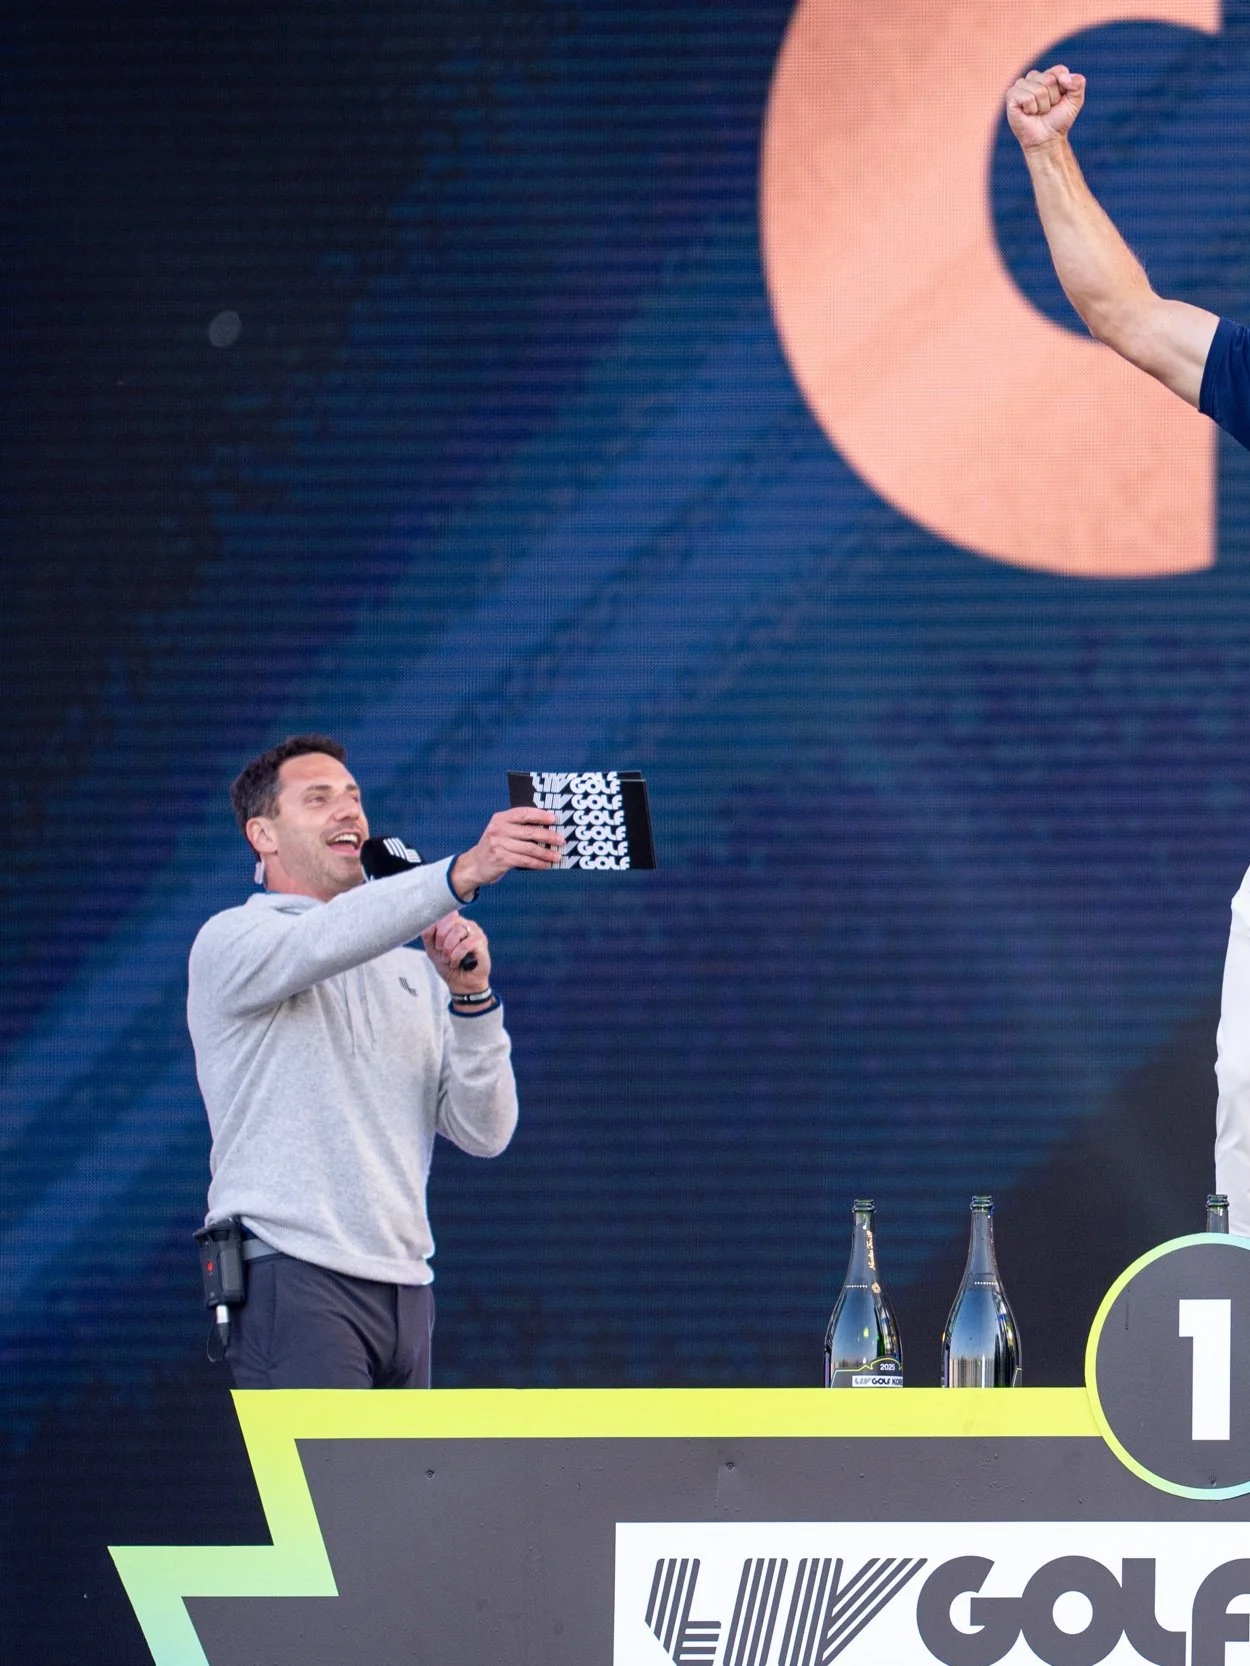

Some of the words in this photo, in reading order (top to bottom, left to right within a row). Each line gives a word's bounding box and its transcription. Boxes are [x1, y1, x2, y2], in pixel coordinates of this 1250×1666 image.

[569, 777, 621, 794] GOLF
[533, 792, 573, 809] LIV
[571, 794, 622, 810] GOLF
[573, 810, 624, 825] GOLF
[575, 825, 626, 840] GOLF
[577, 840, 628, 856] GOLF
[579, 856, 630, 870] GOLF
[880, 1363, 896, 1371] 2025
[1179, 1299, 1231, 1440] 1
[871, 1377, 891, 1385] GOLF
[645, 1557, 929, 1666] LIV
